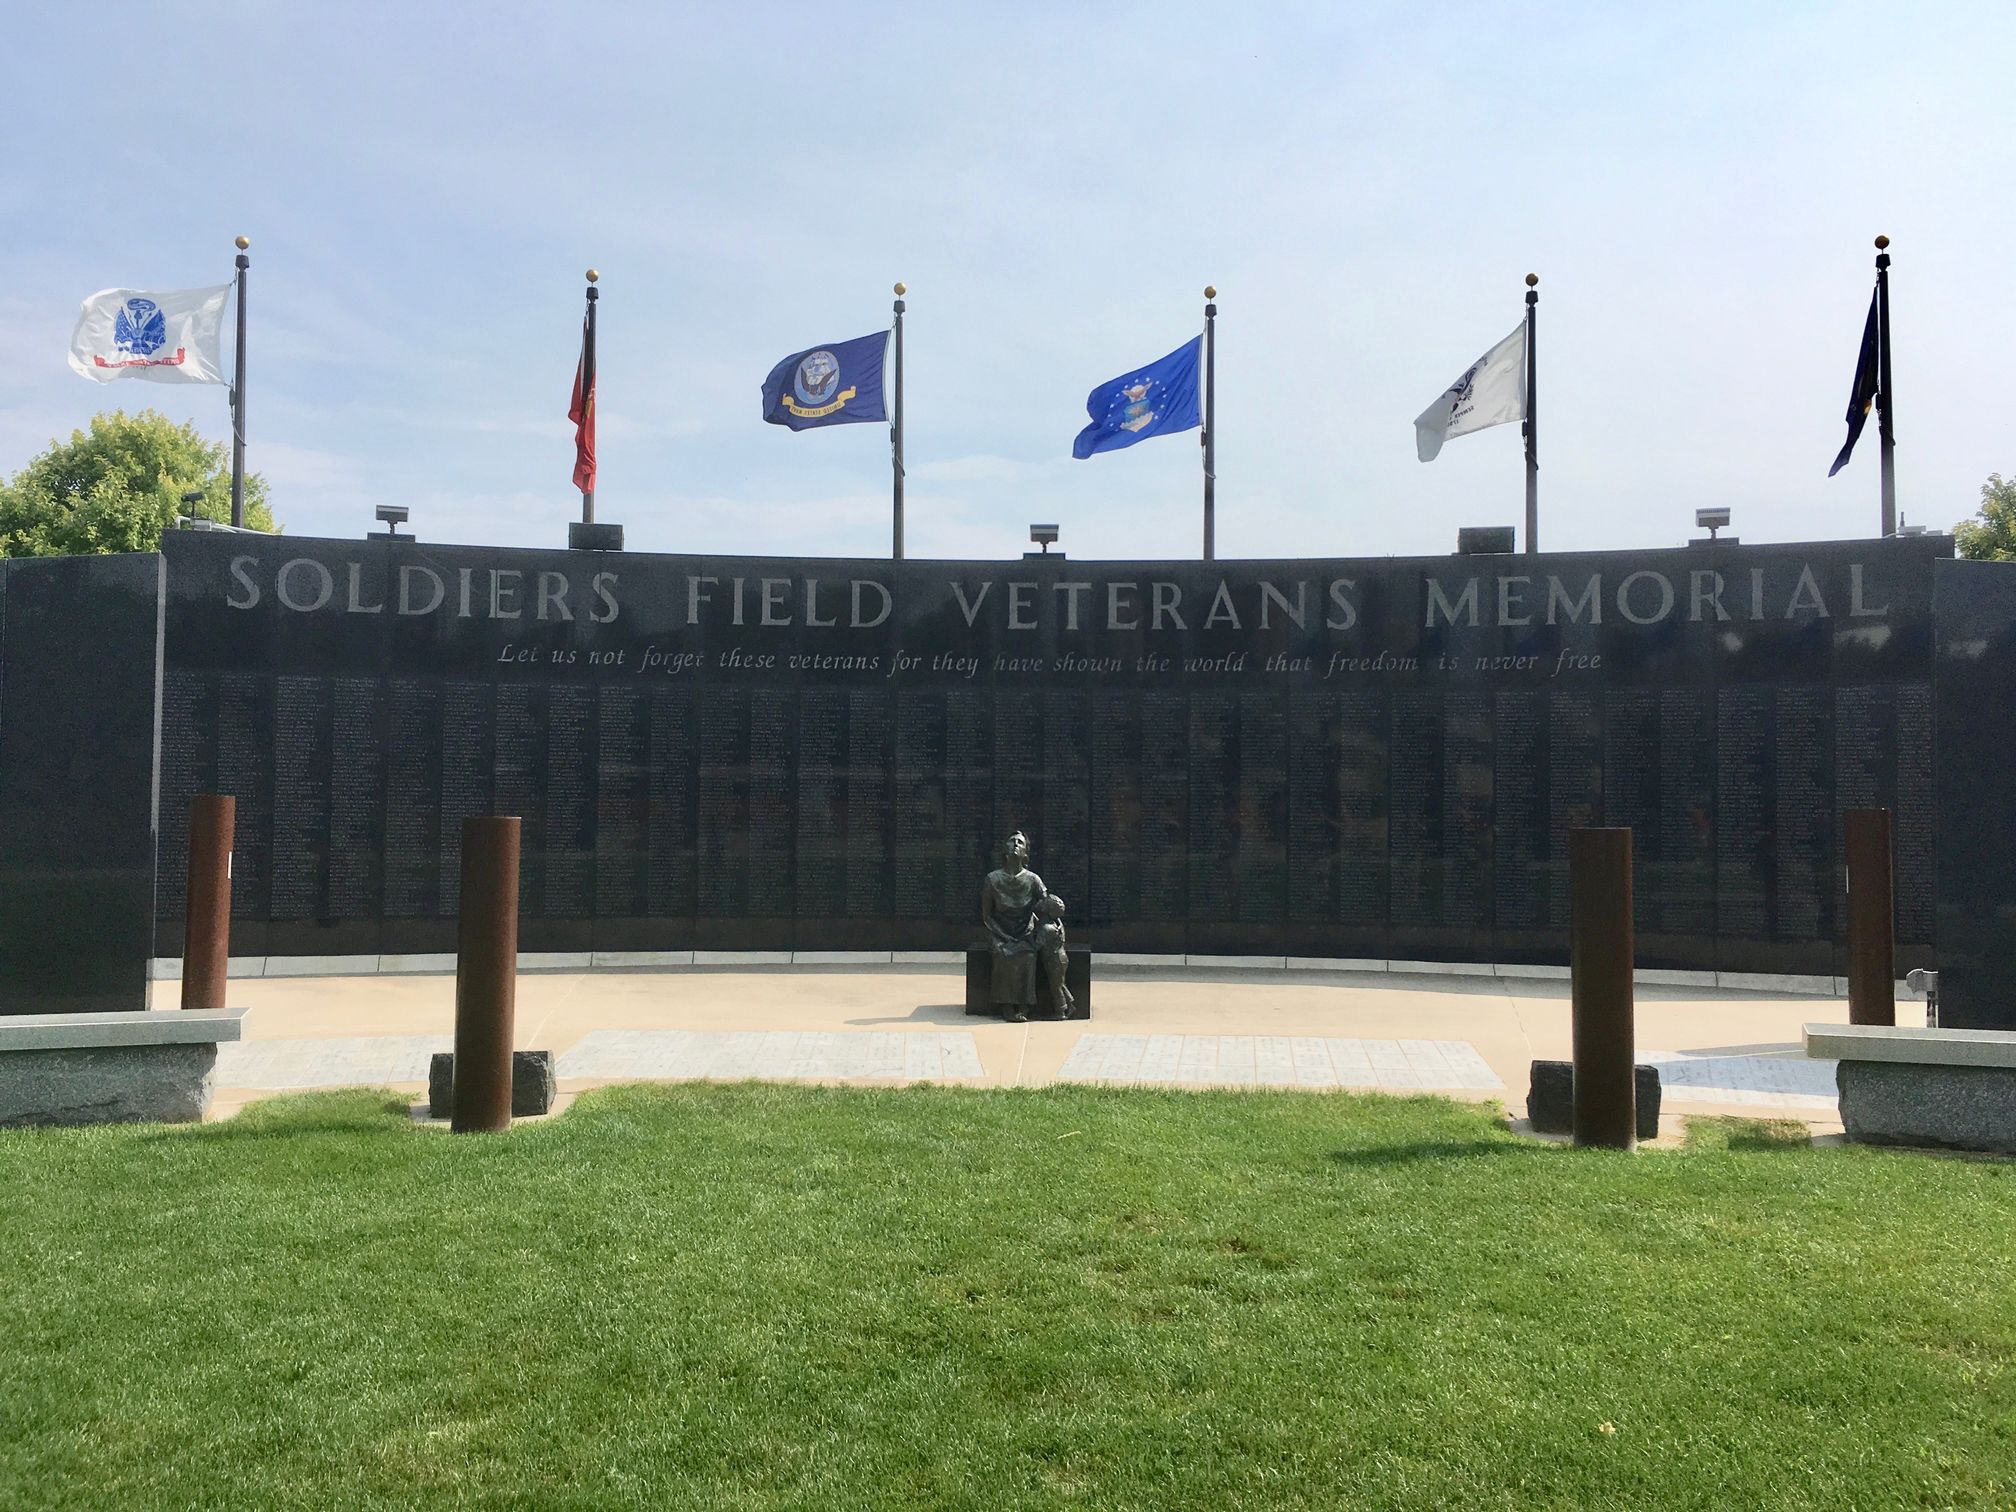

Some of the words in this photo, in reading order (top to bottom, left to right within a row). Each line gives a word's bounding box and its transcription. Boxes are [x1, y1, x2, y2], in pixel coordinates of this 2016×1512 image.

[226, 555, 620, 624] SOLDIERS
[686, 575, 893, 628] FIELD
[948, 577, 1358, 631] VETERANS
[1423, 561, 1890, 628] MEMORIAL
[497, 643, 538, 663] Let
[551, 649, 577, 664] us
[588, 649, 625, 665] not
[636, 644, 705, 674] forget
[718, 647, 776, 669] these
[788, 652, 880, 670] veterans
[885, 649, 922, 679] for
[932, 651, 980, 679] they
[992, 651, 1044, 672] have
[1052, 651, 1122, 672] shown
[1135, 651, 1171, 672] the
[1183, 651, 1250, 672] world
[1265, 651, 1313, 672] that
[1323, 650, 1419, 680] freedom
[1438, 652, 1460, 671] is
[1475, 654, 1539, 671] never
[1550, 648, 1602, 678] free
